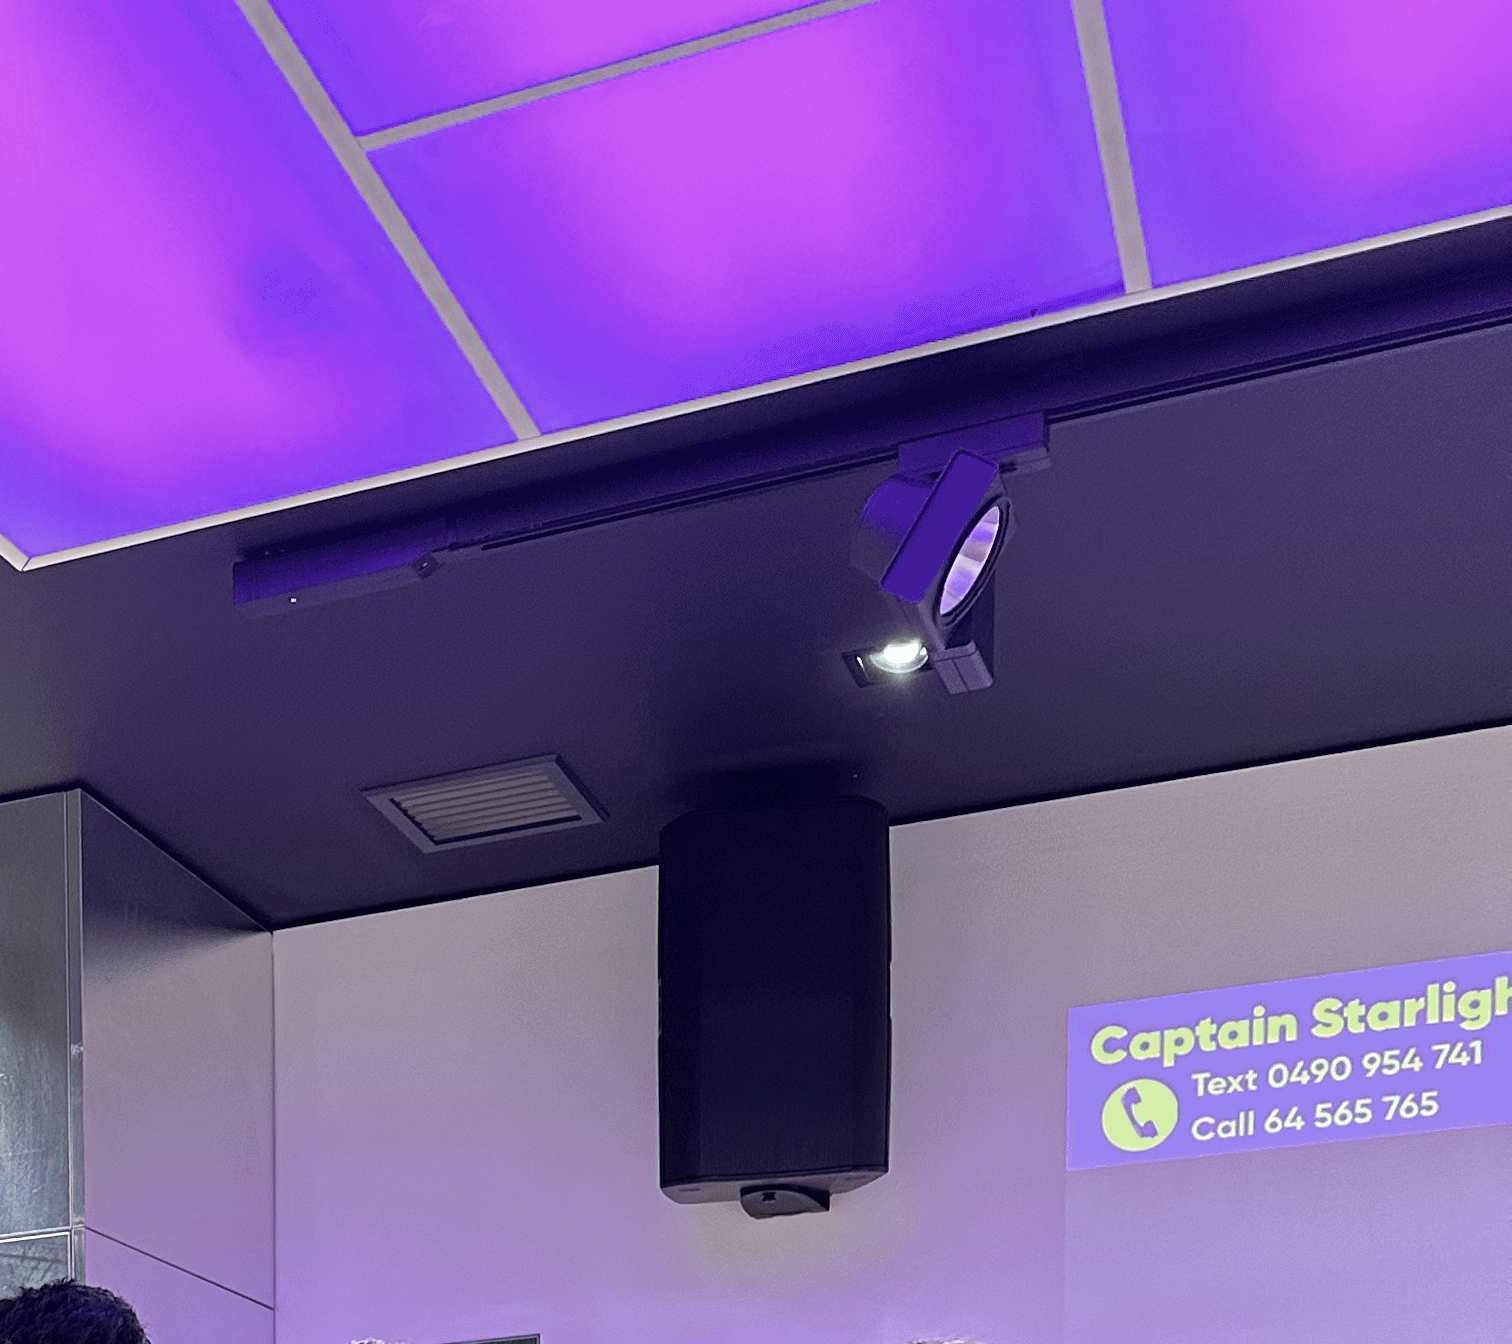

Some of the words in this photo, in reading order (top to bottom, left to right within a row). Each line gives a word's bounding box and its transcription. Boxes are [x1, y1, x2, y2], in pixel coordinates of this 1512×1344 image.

[1090, 1004, 1298, 1068] Captain
[1311, 976, 1512, 1038] Starligh
[1191, 1070, 1258, 1097] Text
[1268, 1055, 1352, 1089] 0490
[1361, 1047, 1423, 1077] 954
[1431, 1040, 1483, 1070] 741
[1191, 1110, 1255, 1141] Call
[1264, 1105, 1305, 1133] 64
[1314, 1098, 1373, 1128] 565
[1381, 1091, 1440, 1121] 765
